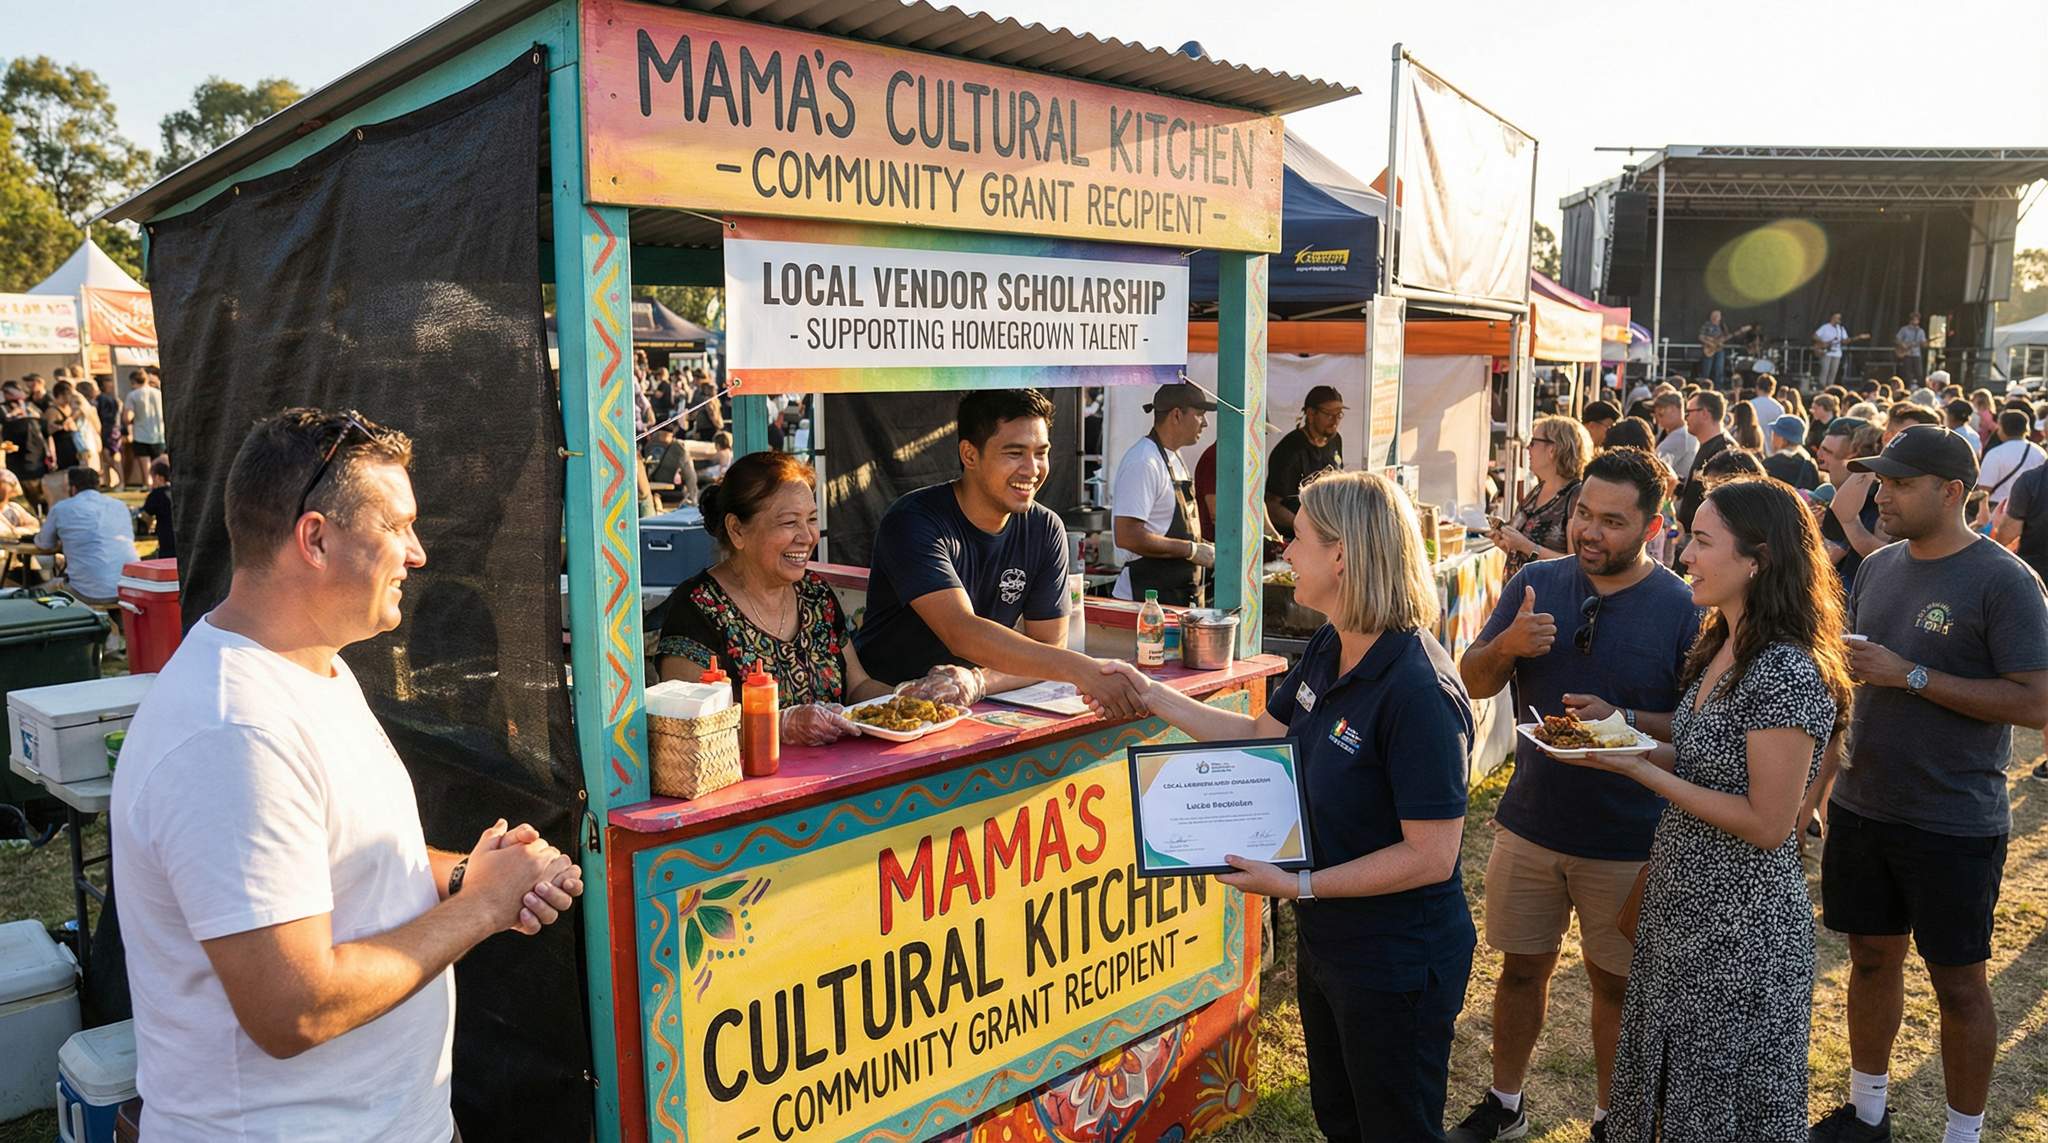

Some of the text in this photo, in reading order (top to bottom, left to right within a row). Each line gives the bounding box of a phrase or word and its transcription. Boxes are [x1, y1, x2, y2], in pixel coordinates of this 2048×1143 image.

[637, 28, 1254, 190] MAMA'S CULTURAL KITCHEN
[752, 147, 965, 213] COMMUNITY
[980, 171, 1075, 223] GRANT
[1087, 183, 1207, 235] RECIPIENT
[763, 261, 1166, 316] LOCAL VENDOR SCHOLARSHIP
[806, 317, 945, 350] SUPPORTING
[951, 319, 1075, 351] HOMEGROWN
[1080, 322, 1139, 351] TALENT
[878, 783, 1106, 936] MAMA'S
[703, 863, 1206, 1102] CULTURAL KITCHEN
[772, 1022, 958, 1142] COMMUNITY
[968, 982, 1054, 1056] GRANT
[1065, 929, 1179, 1014] RECIPIENT
